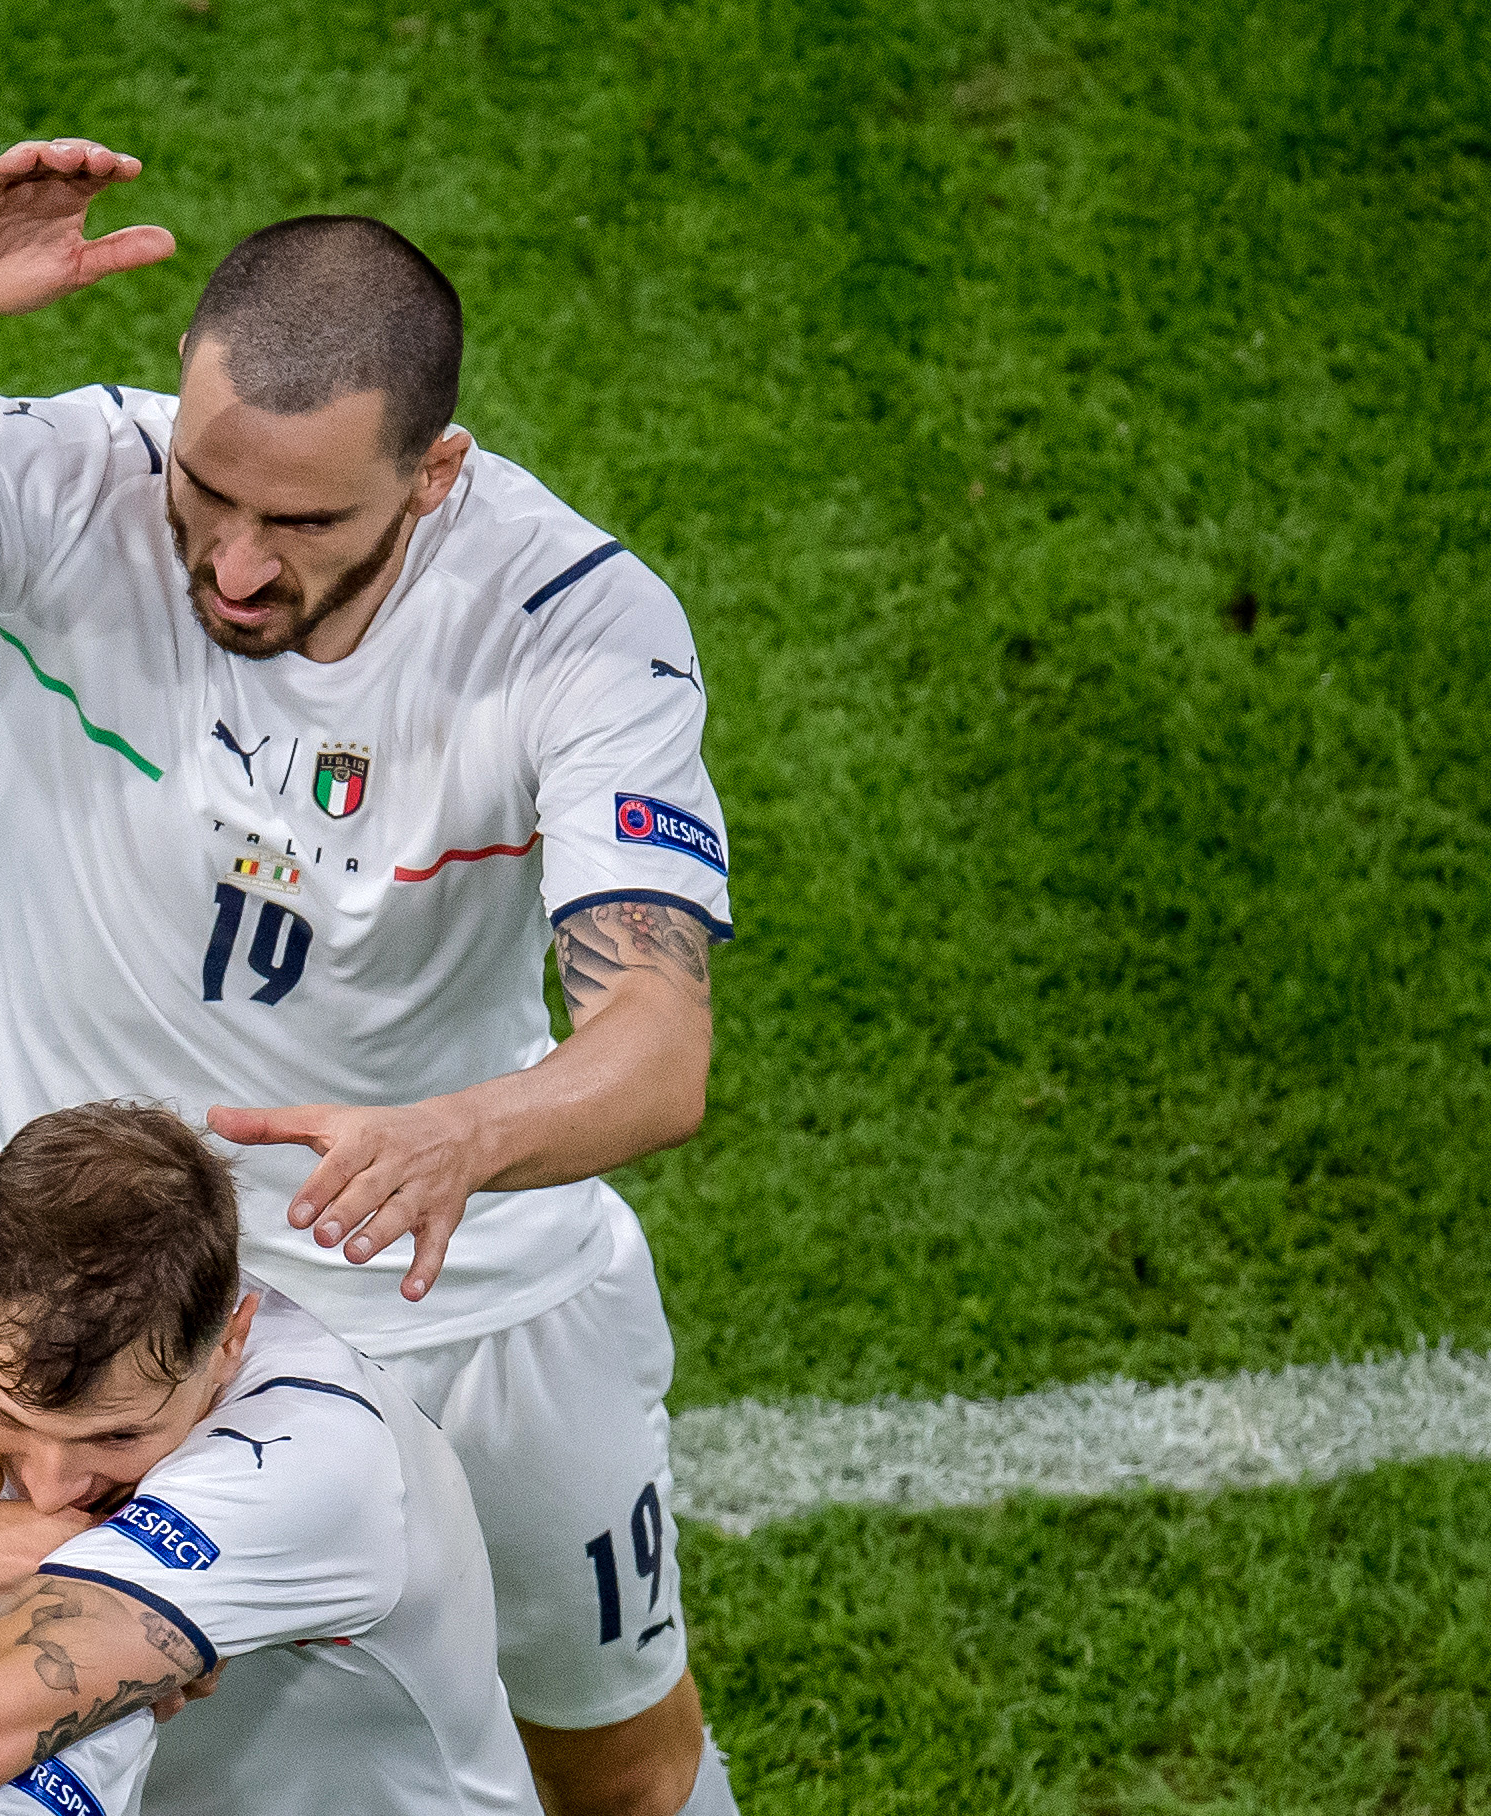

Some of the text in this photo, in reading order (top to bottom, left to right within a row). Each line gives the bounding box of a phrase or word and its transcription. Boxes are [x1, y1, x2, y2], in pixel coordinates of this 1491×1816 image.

[320, 755, 366, 771] ITALIA
[212, 819, 358, 873] TALIA
[656, 813, 723, 863] RESPECT
[203, 881, 314, 1007] 19
[117, 1503, 211, 1571] RESPECT
[585, 1480, 663, 1646] 19
